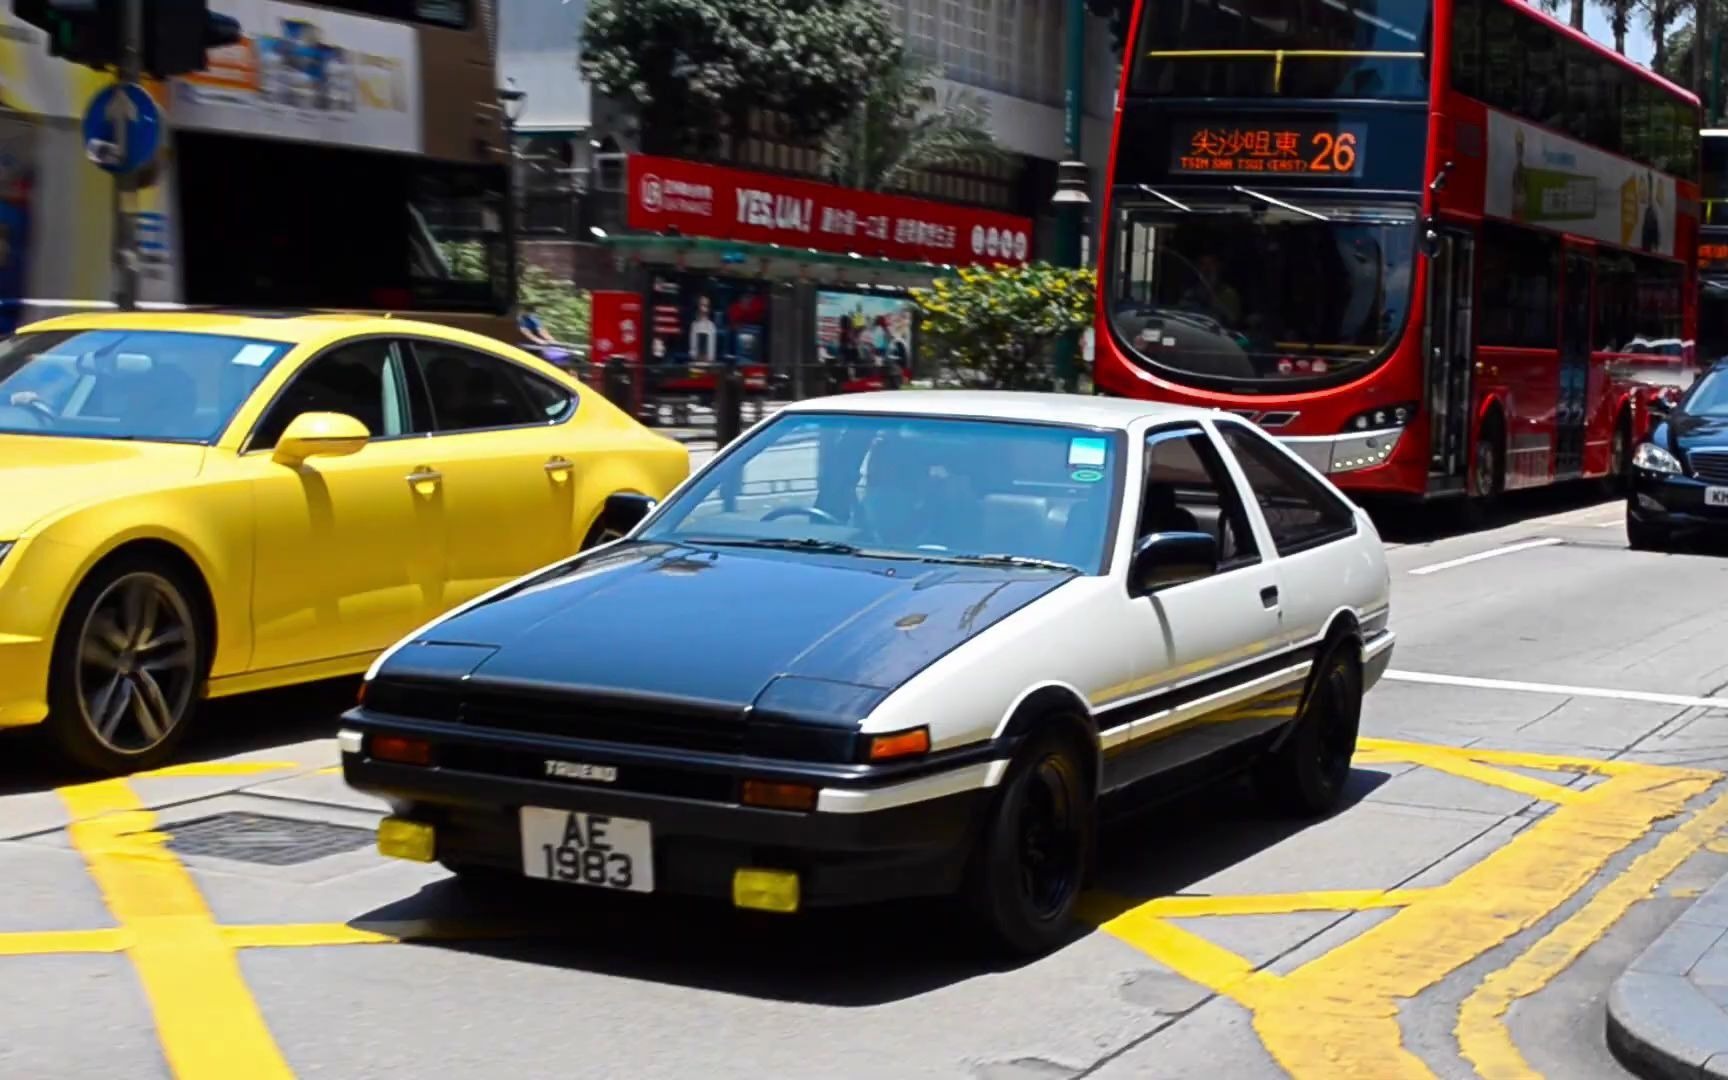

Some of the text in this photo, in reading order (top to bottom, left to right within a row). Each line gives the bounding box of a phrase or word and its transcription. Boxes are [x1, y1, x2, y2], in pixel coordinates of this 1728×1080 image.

[1192, 128, 1300, 157] 尖沙咀東
[1310, 132, 1356, 172] 26
[1180, 157, 1208, 169] TSIM
[544, 760, 617, 782] TRUENO
[562, 812, 613, 850] AE
[543, 844, 633, 888] 1983
